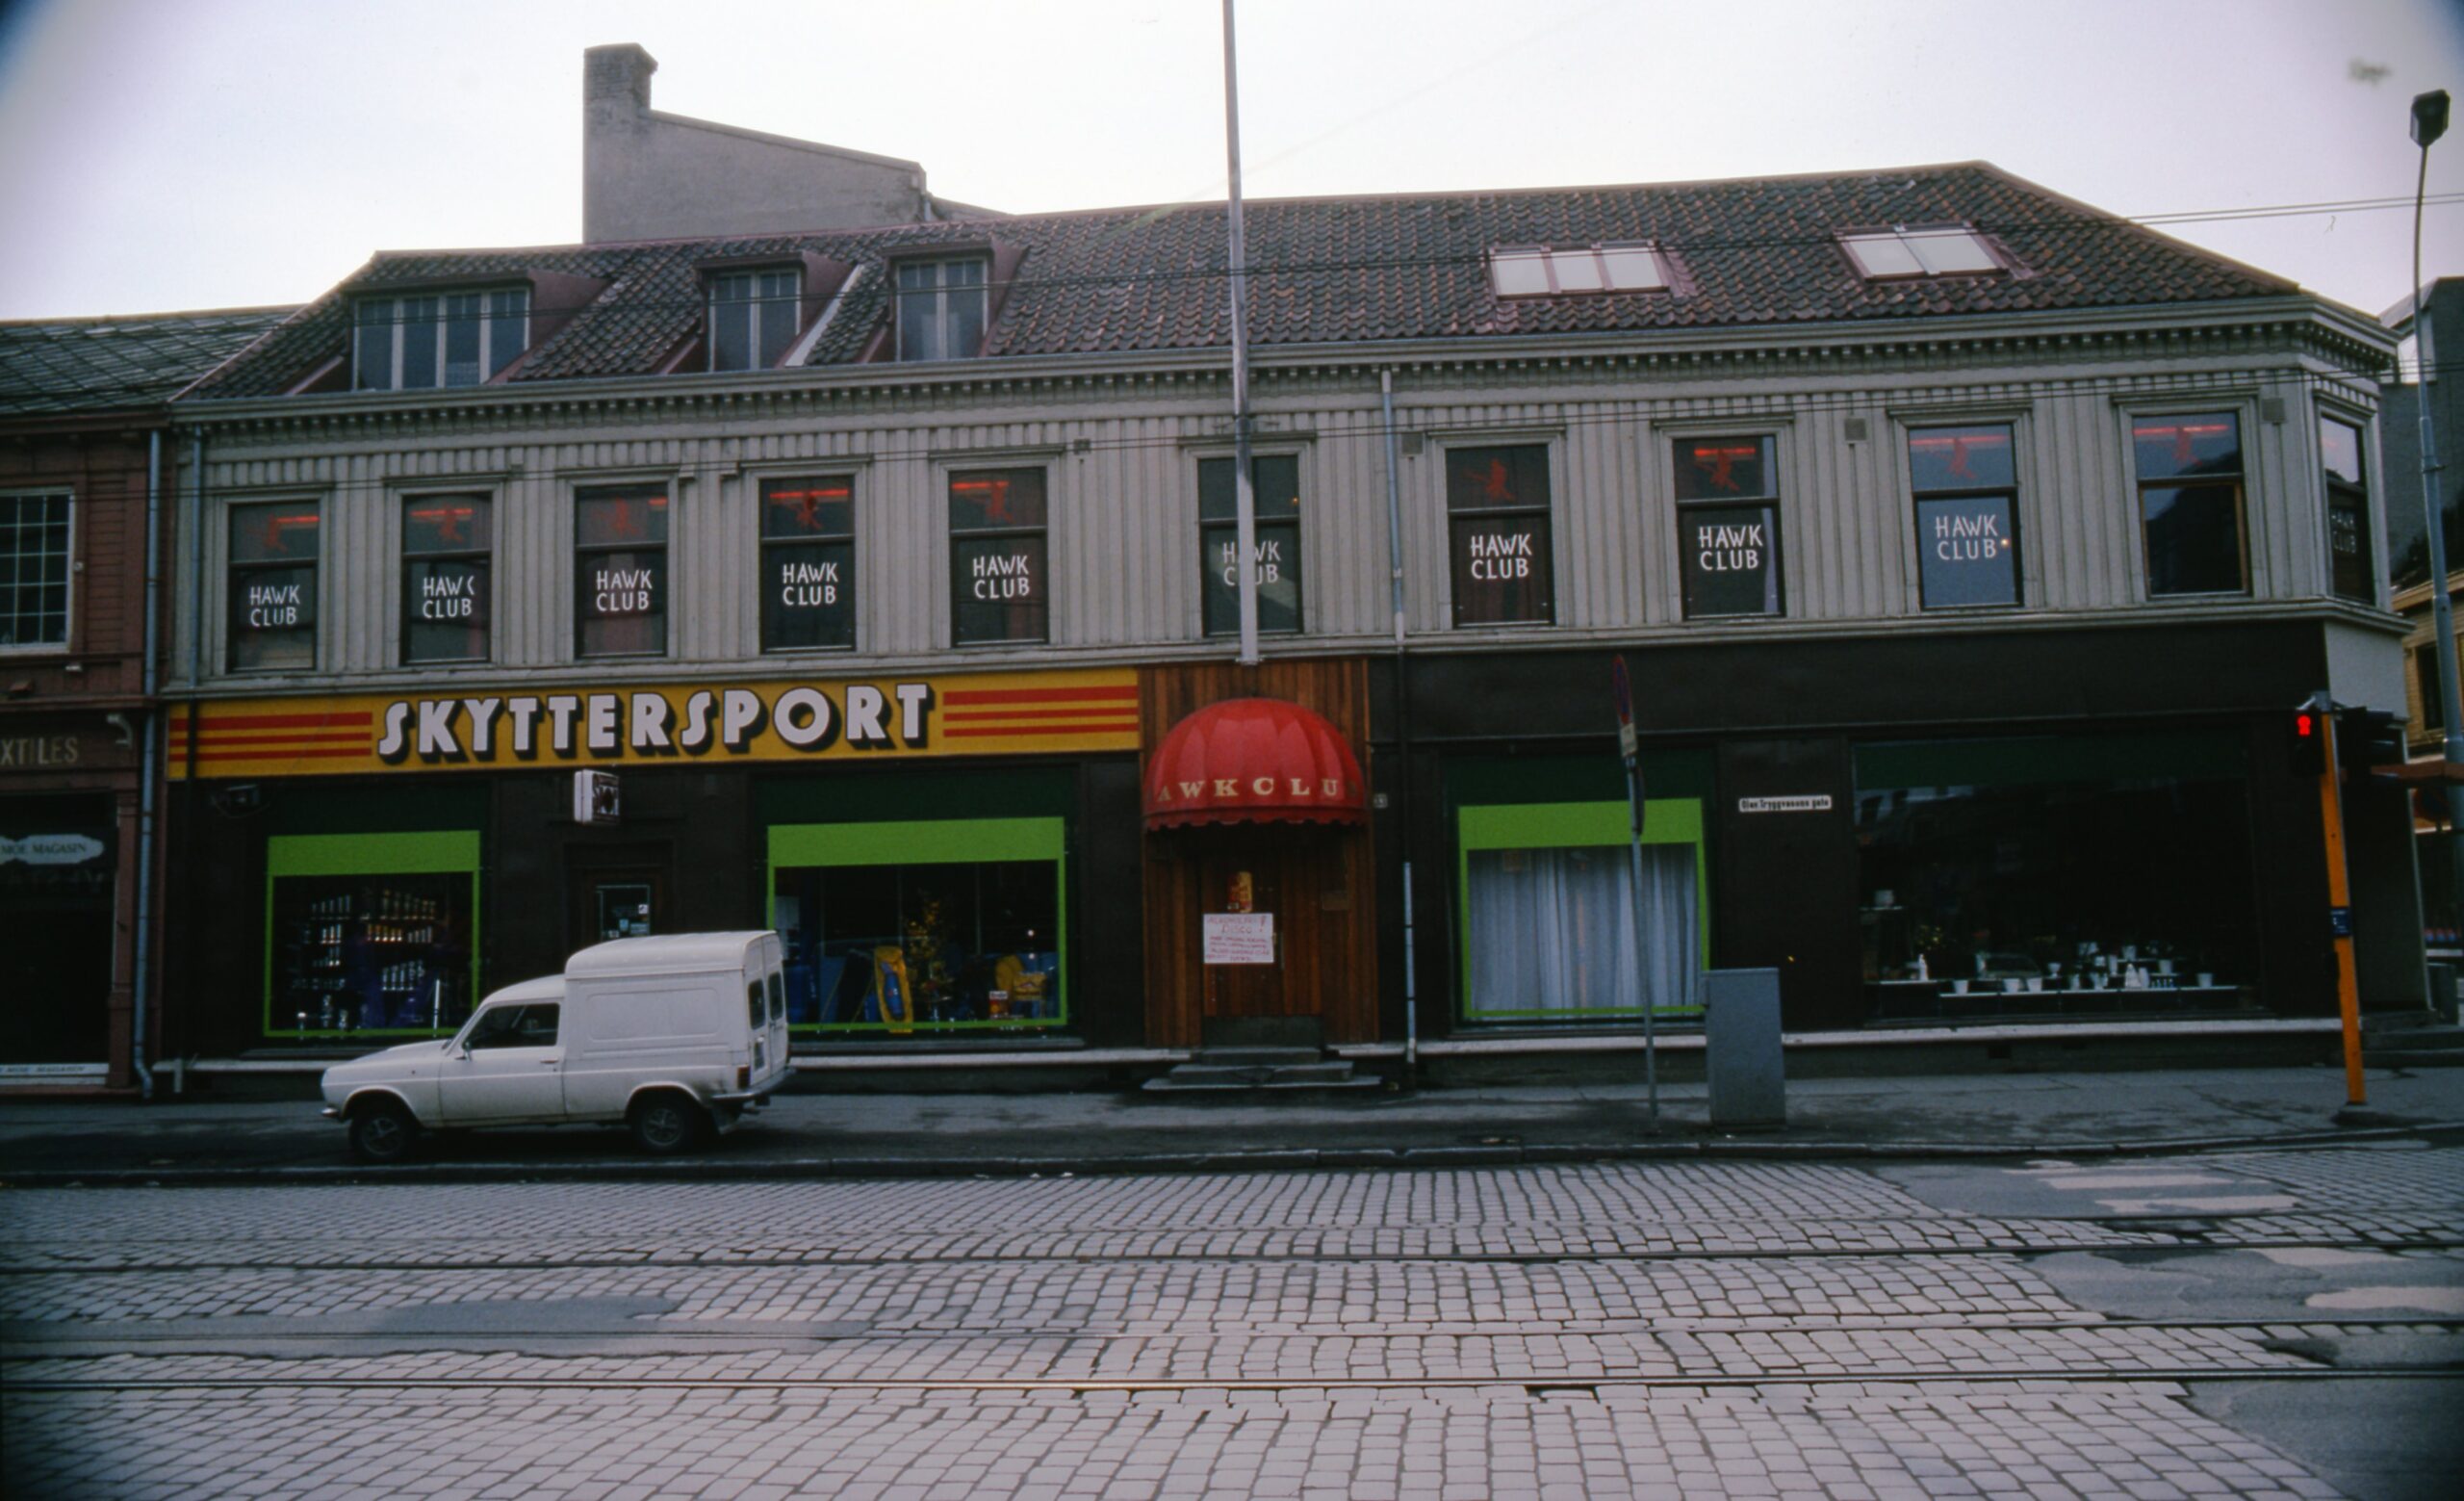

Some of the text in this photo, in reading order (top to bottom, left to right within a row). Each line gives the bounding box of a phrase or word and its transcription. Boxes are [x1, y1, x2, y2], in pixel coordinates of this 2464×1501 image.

[1699, 525, 1763, 549] HAWK
[1935, 514, 1998, 538] HAWK
[1222, 541, 1282, 564] HWK
[1471, 533, 1532, 557] HAWK
[1937, 538, 1997, 560] CLUB
[973, 555, 1029, 577] HAWK
[1471, 557, 1528, 580] CLUB
[1701, 549, 1759, 571] CLUB
[596, 569, 653, 590] HAWK
[783, 562, 838, 584] HAWK
[1223, 563, 1278, 586] CUB
[249, 585, 300, 606] HAWK
[783, 584, 836, 606] CLUB
[974, 577, 1030, 599] CLUB
[423, 598, 473, 619] CLUB
[596, 590, 649, 611] CLUB
[249, 607, 297, 627] CLUB
[378, 683, 932, 763] SKYTTERSPORT
[1147, 778, 1241, 802] AWK
[1811, 797, 1830, 810] gate
[32, 841, 88, 855] MAGASIN
